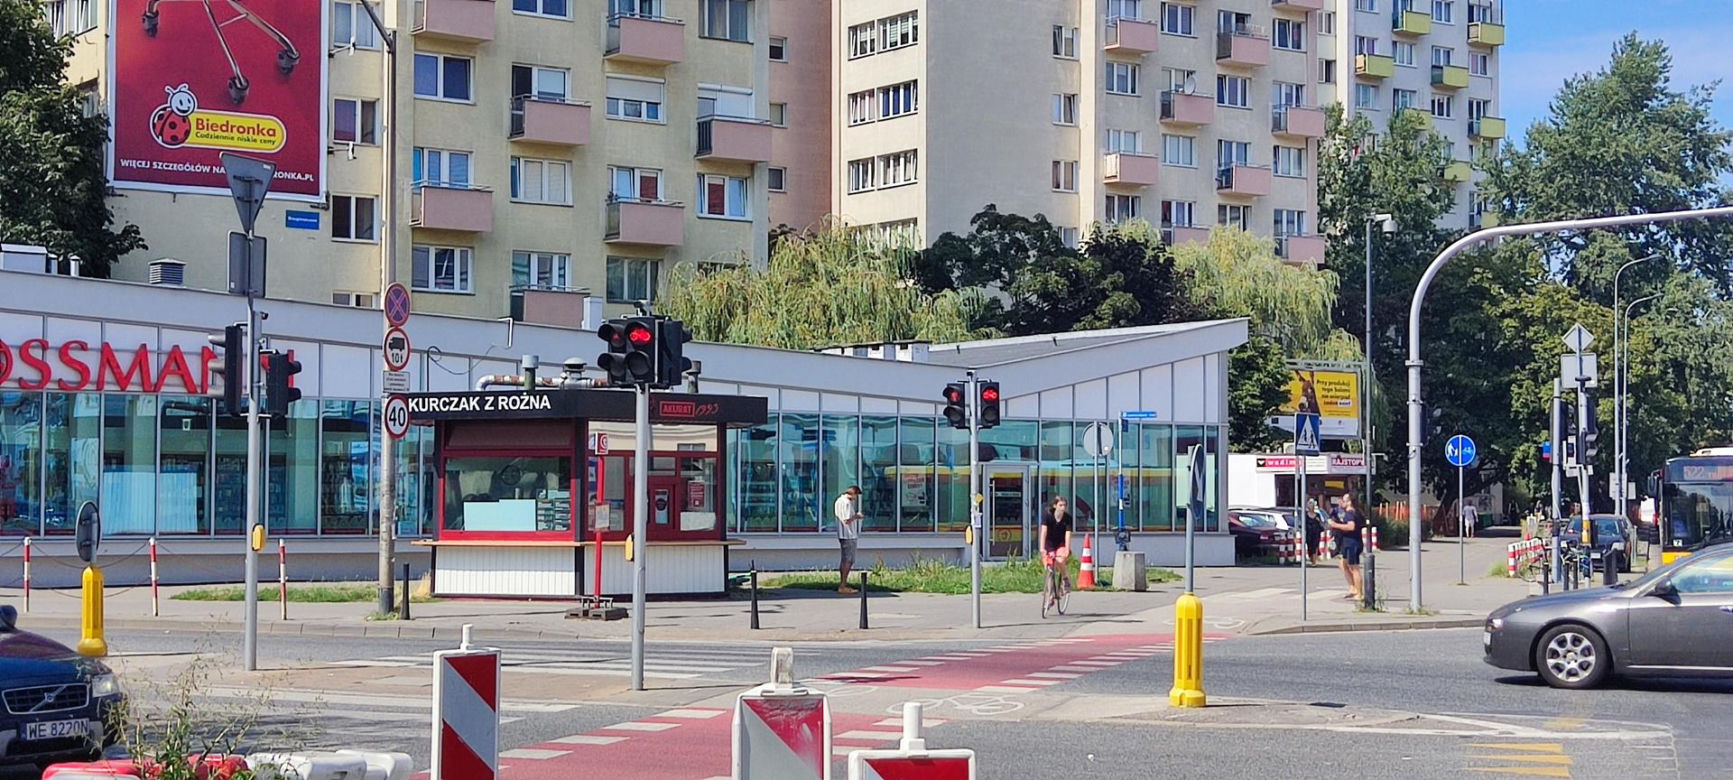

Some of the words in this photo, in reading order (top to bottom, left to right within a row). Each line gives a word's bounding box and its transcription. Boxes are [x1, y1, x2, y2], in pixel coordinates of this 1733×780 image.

[195, 117, 277, 138] Biedronka
[195, 131, 235, 141] Codziennie
[237, 135, 258, 143] niskie
[120, 158, 150, 169] WIĘCEJ
[152, 160, 211, 174] SZCZEGÓŁÓW
[212, 166, 226, 174] NA
[408, 397, 480, 412] KURCZAK
[484, 396, 495, 410] Z
[498, 392, 551, 410] ROŻNA
[663, 404, 691, 414] AKURAT
[388, 406, 406, 427] 40
[28, 723, 47, 739] WE
